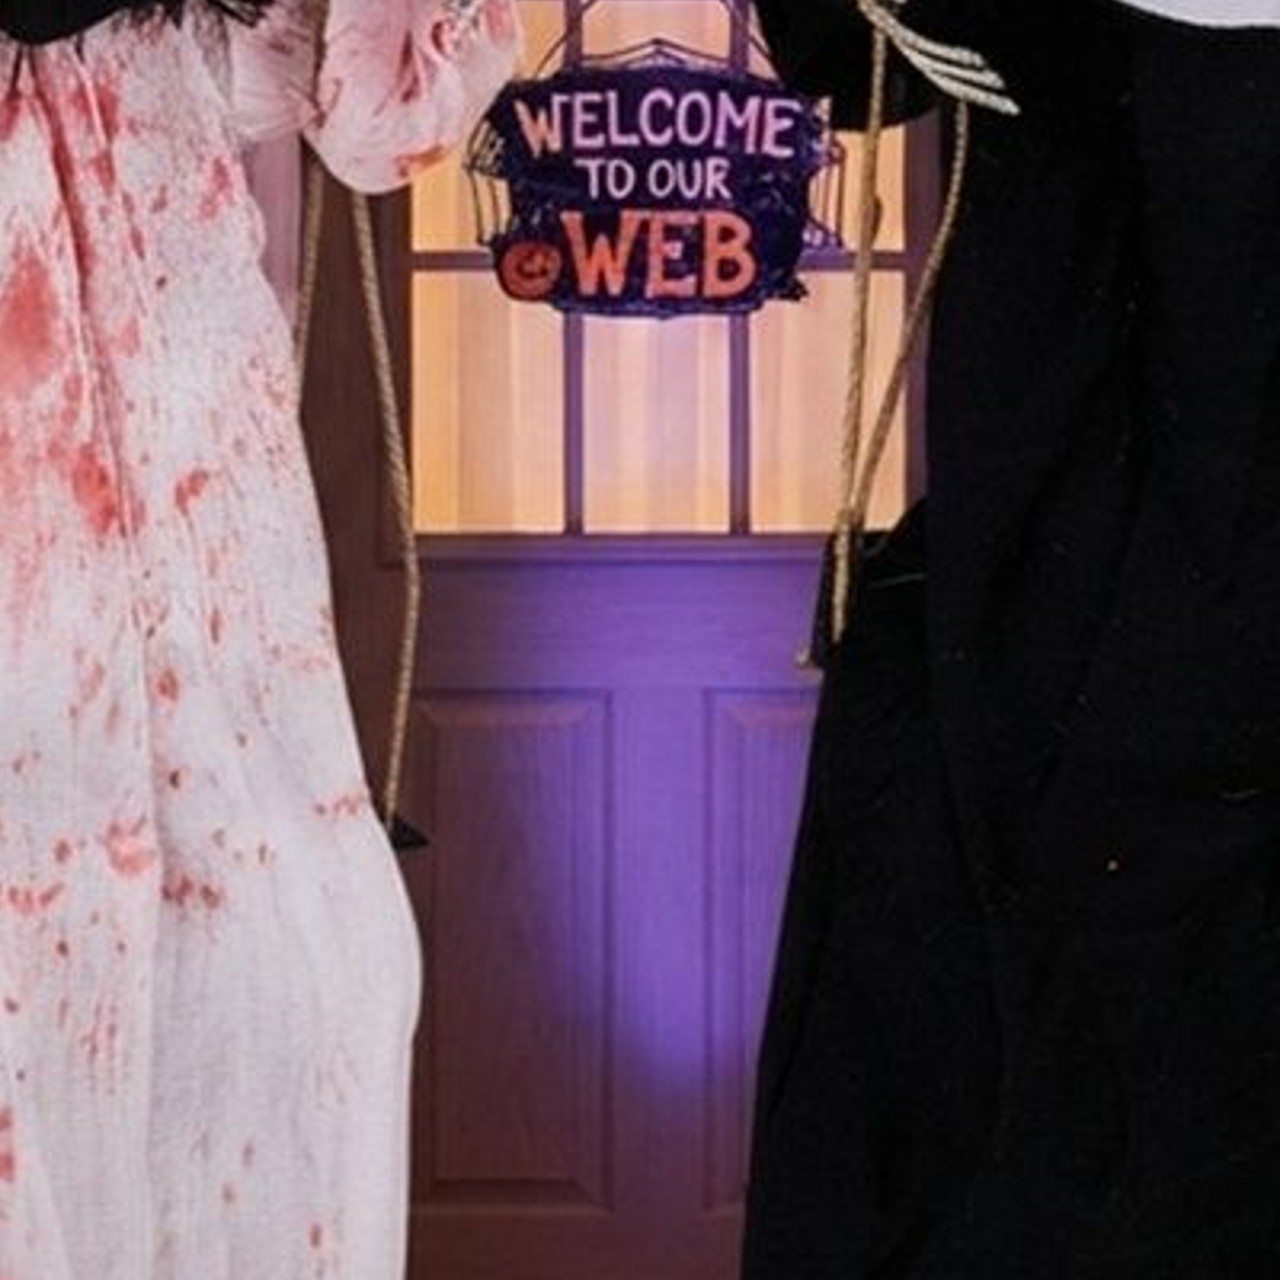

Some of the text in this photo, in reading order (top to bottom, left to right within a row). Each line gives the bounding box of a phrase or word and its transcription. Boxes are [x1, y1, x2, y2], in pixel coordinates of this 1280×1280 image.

[515, 89, 803, 158] WELCOME
[574, 158, 732, 199] TO OUR
[560, 209, 757, 298] WEB
